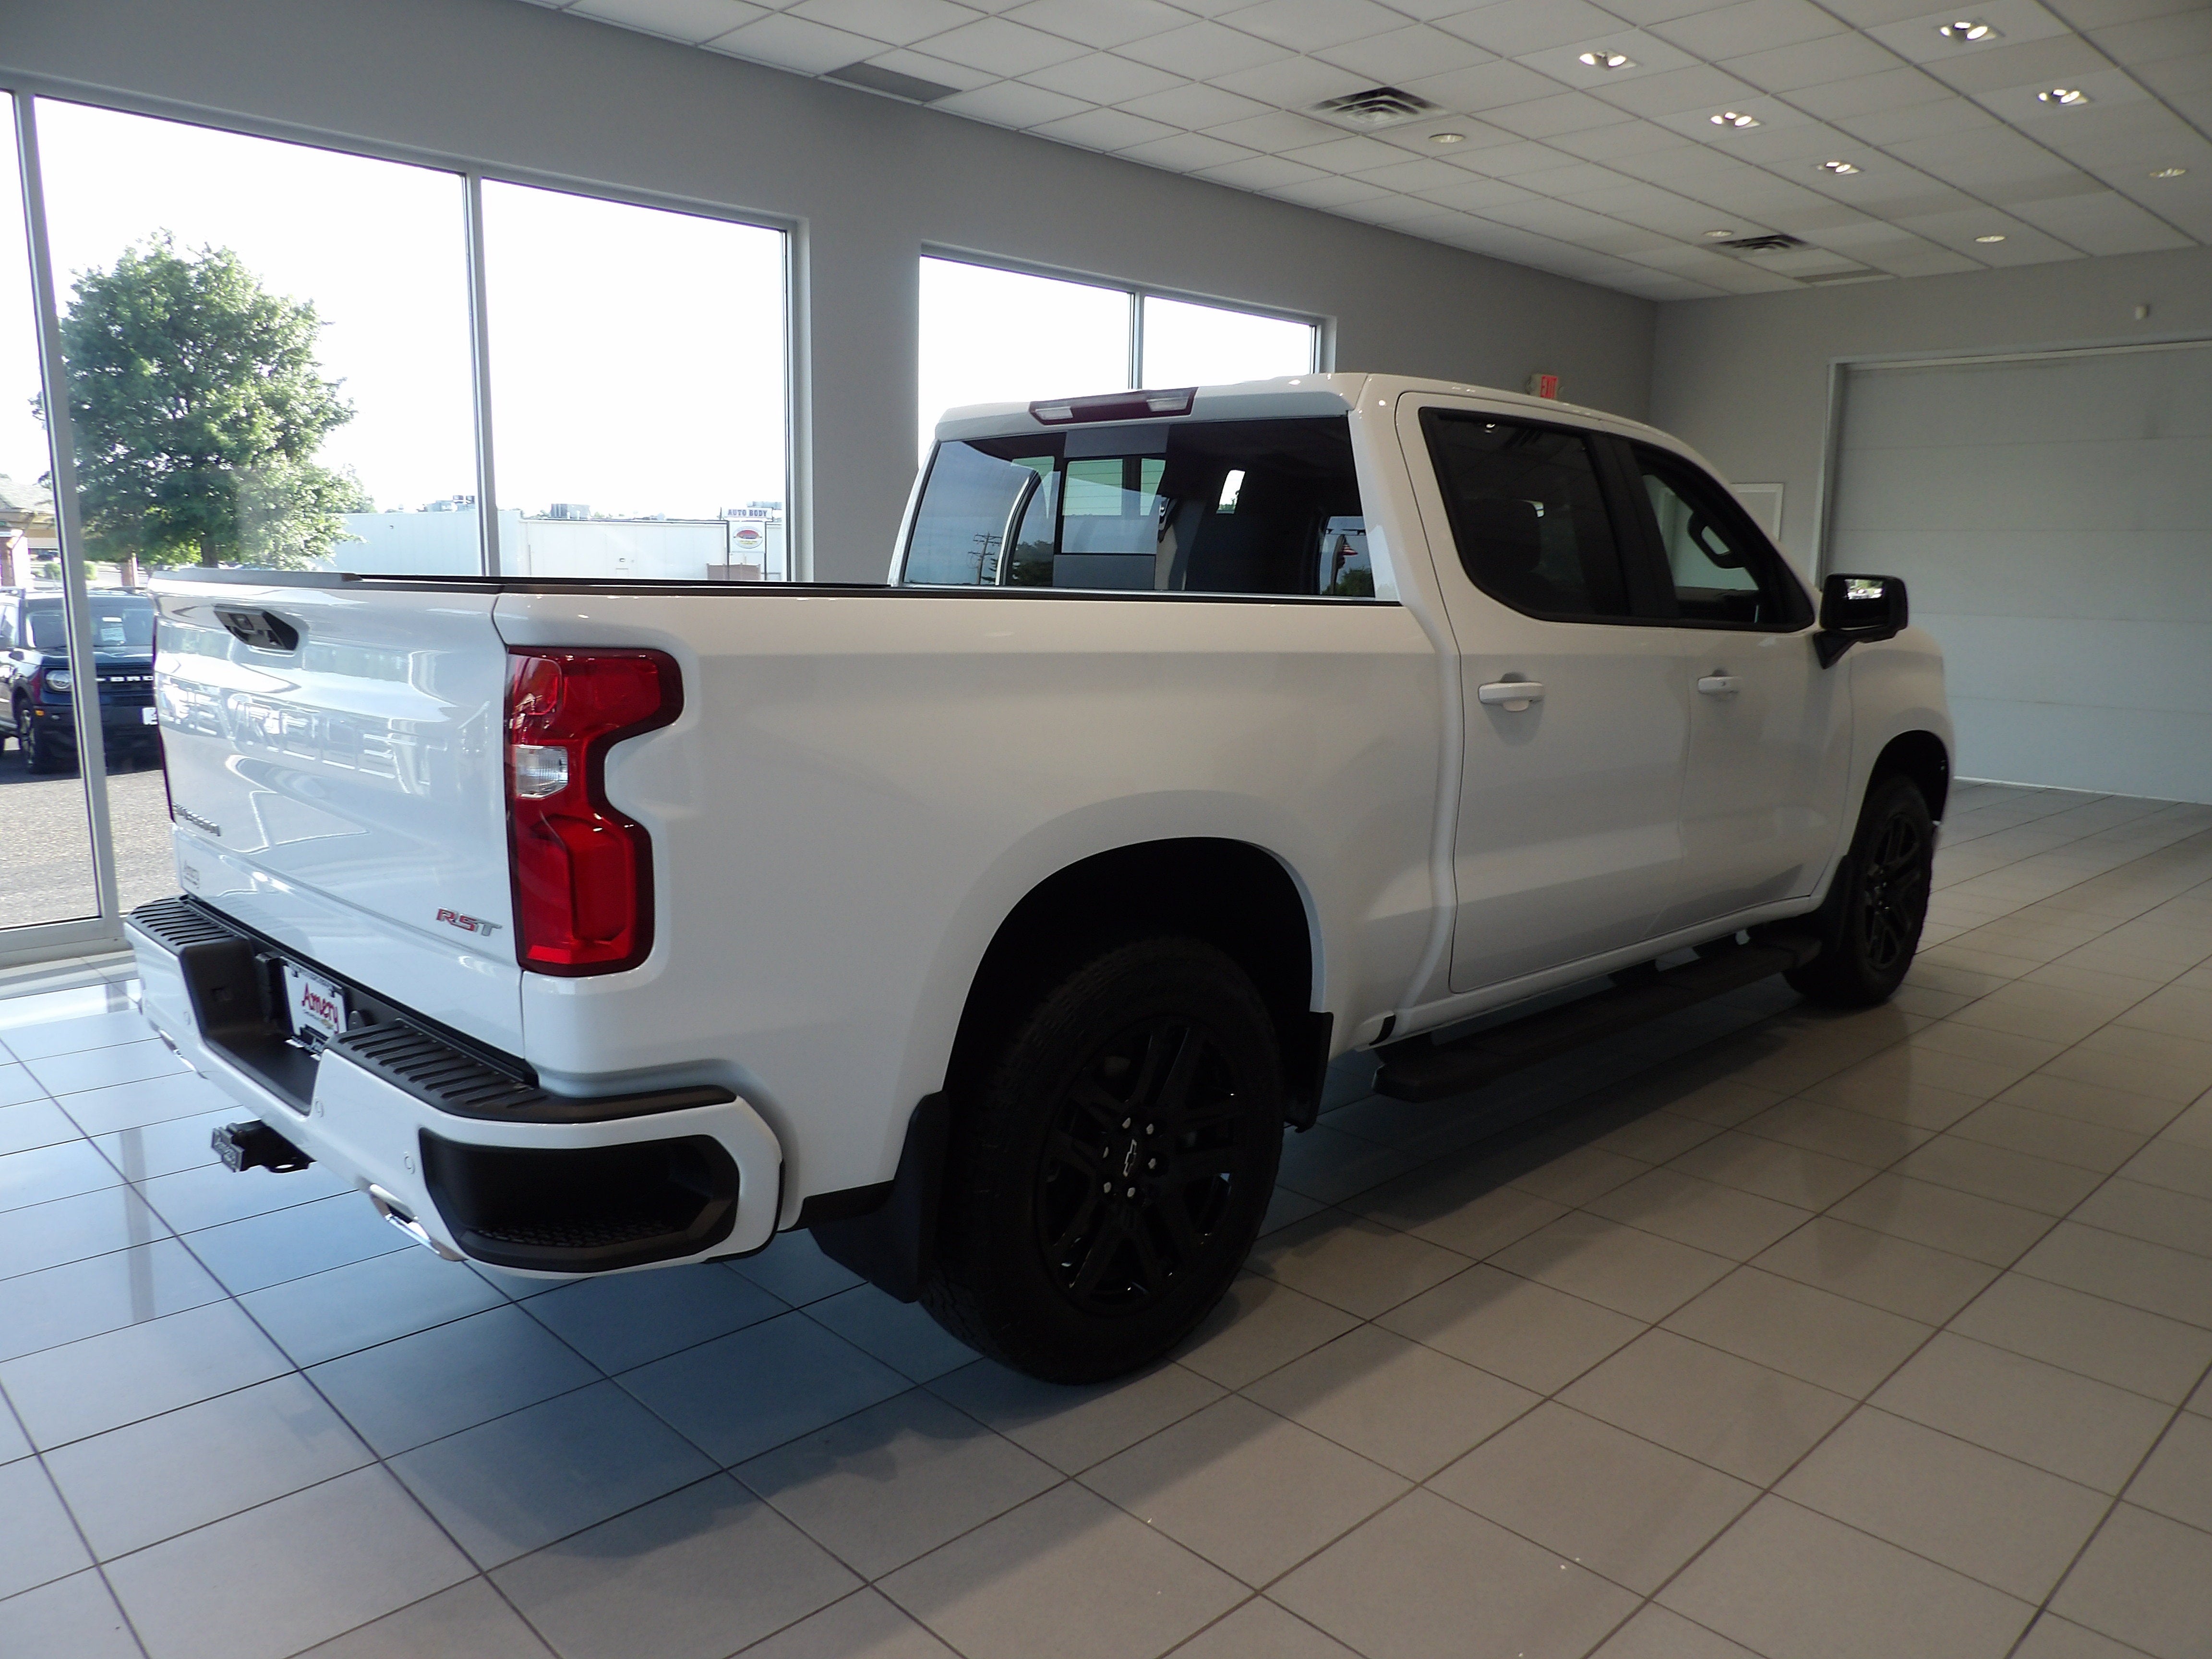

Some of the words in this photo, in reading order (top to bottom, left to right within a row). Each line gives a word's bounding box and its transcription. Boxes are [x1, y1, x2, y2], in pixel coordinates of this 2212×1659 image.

[749, 509, 768, 517] BODY
[435, 906, 503, 937] RST
[301, 982, 339, 1034] Amery
